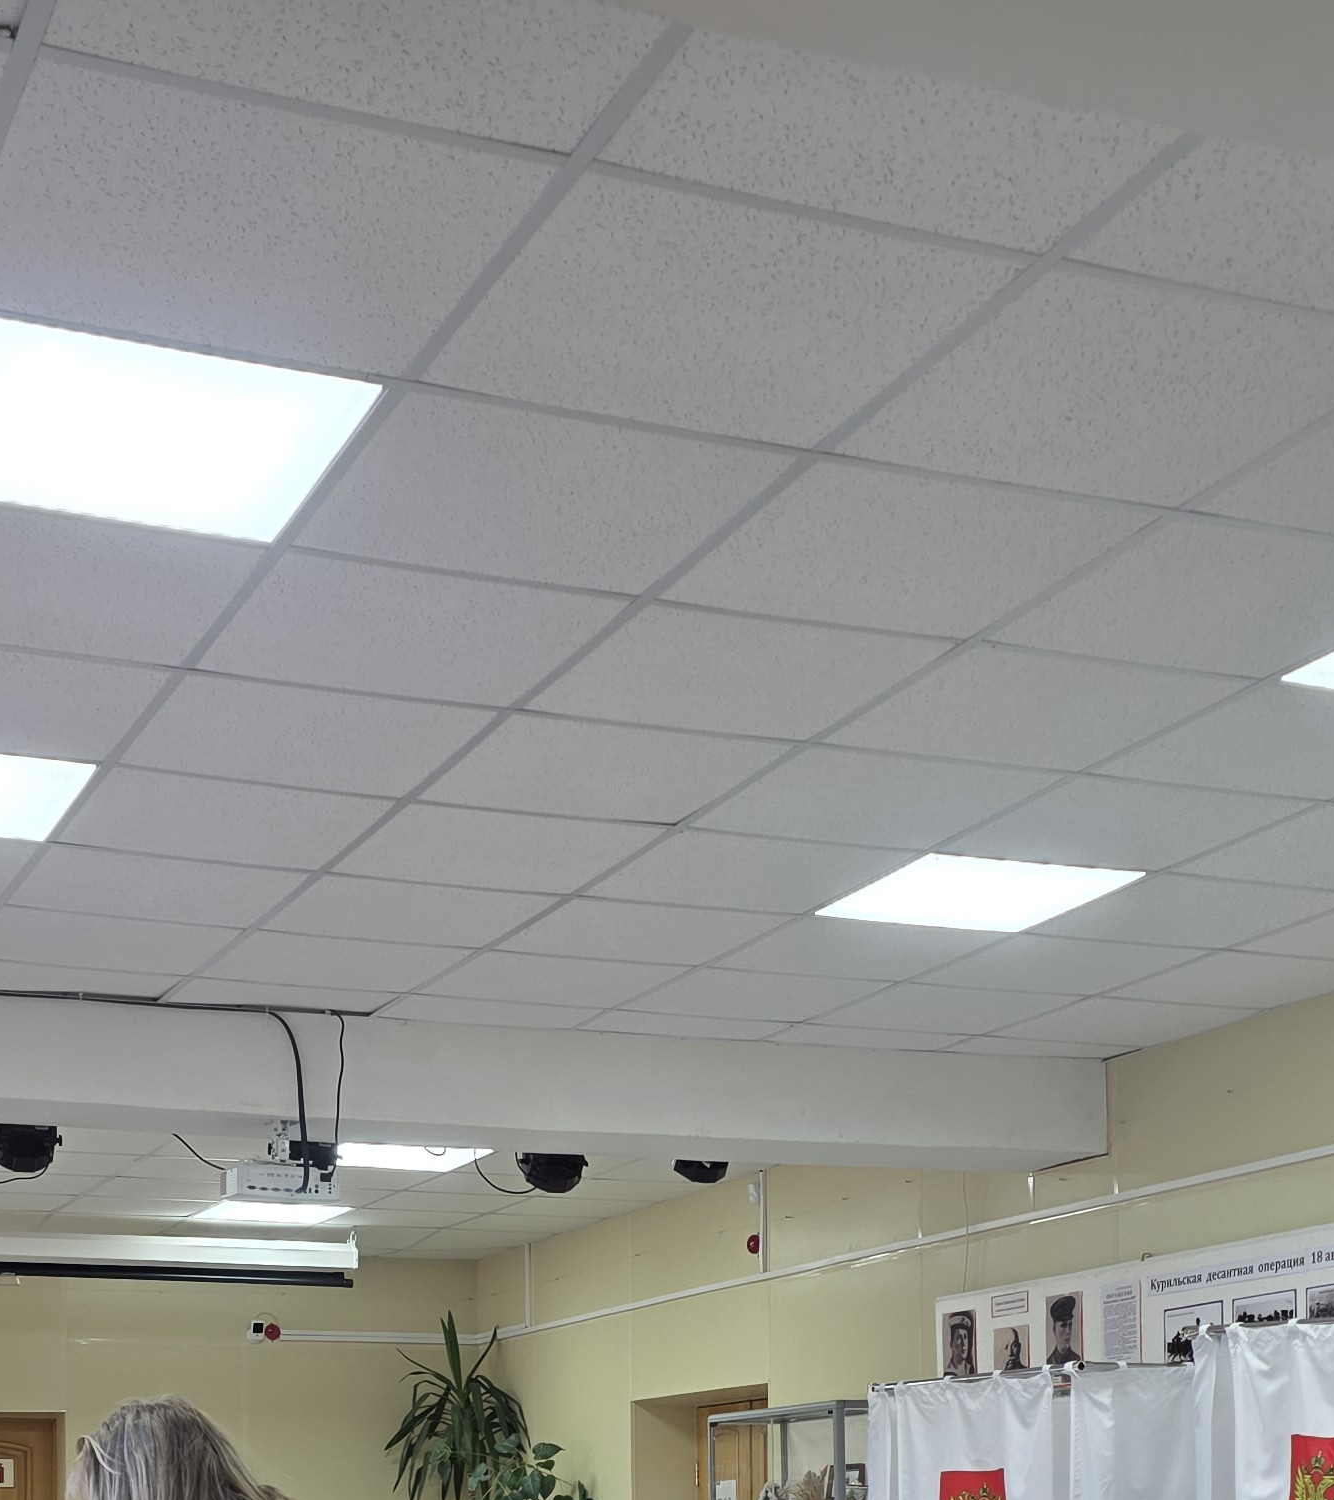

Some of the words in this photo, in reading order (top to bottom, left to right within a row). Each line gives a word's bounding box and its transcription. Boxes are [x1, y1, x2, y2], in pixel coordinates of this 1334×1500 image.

[1150, 1273, 1202, 1292] Курильская
[1205, 1264, 1254, 1283] десантная
[1257, 1256, 1305, 1274] операция
[1311, 1250, 1323, 1264] 18
